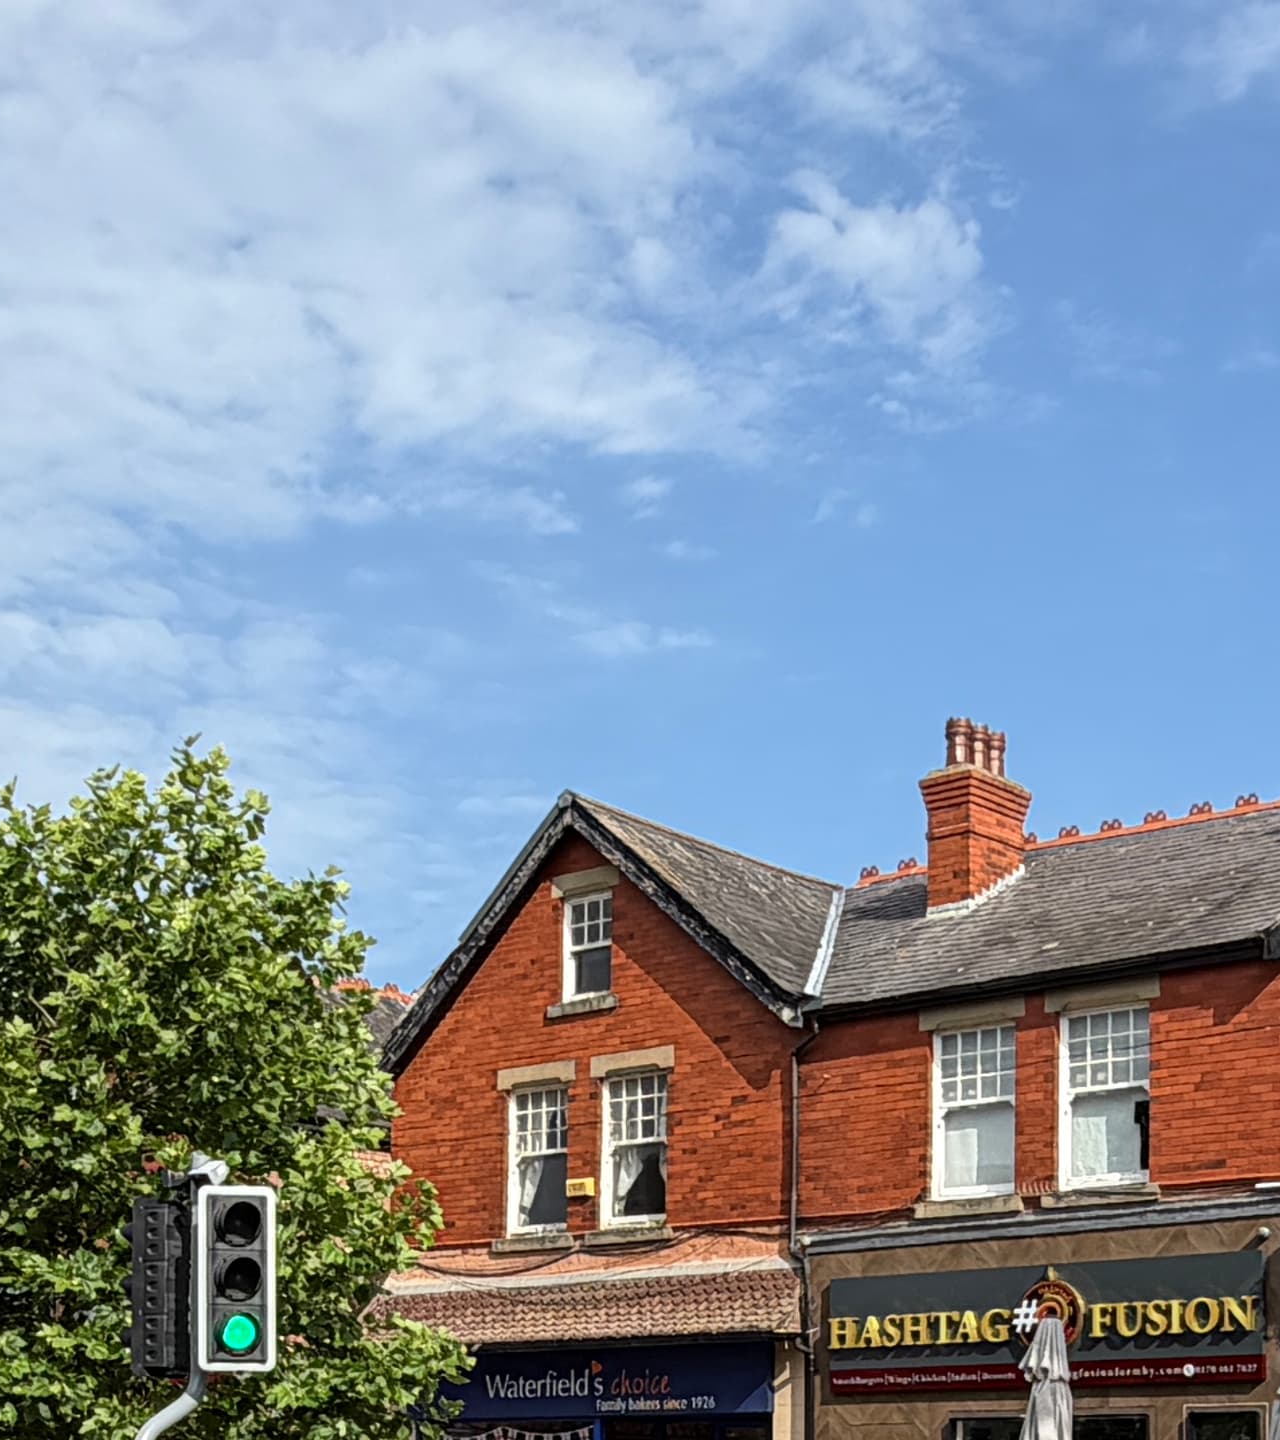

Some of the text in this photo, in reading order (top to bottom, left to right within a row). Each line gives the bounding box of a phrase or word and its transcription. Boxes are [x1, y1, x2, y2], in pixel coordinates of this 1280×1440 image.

[828, 1309, 1011, 1349] HASHTAG
[1089, 1296, 1259, 1339] FUSION
[611, 1369, 672, 1396] choice
[596, 1395, 716, 1414] Family bakers since 1926
